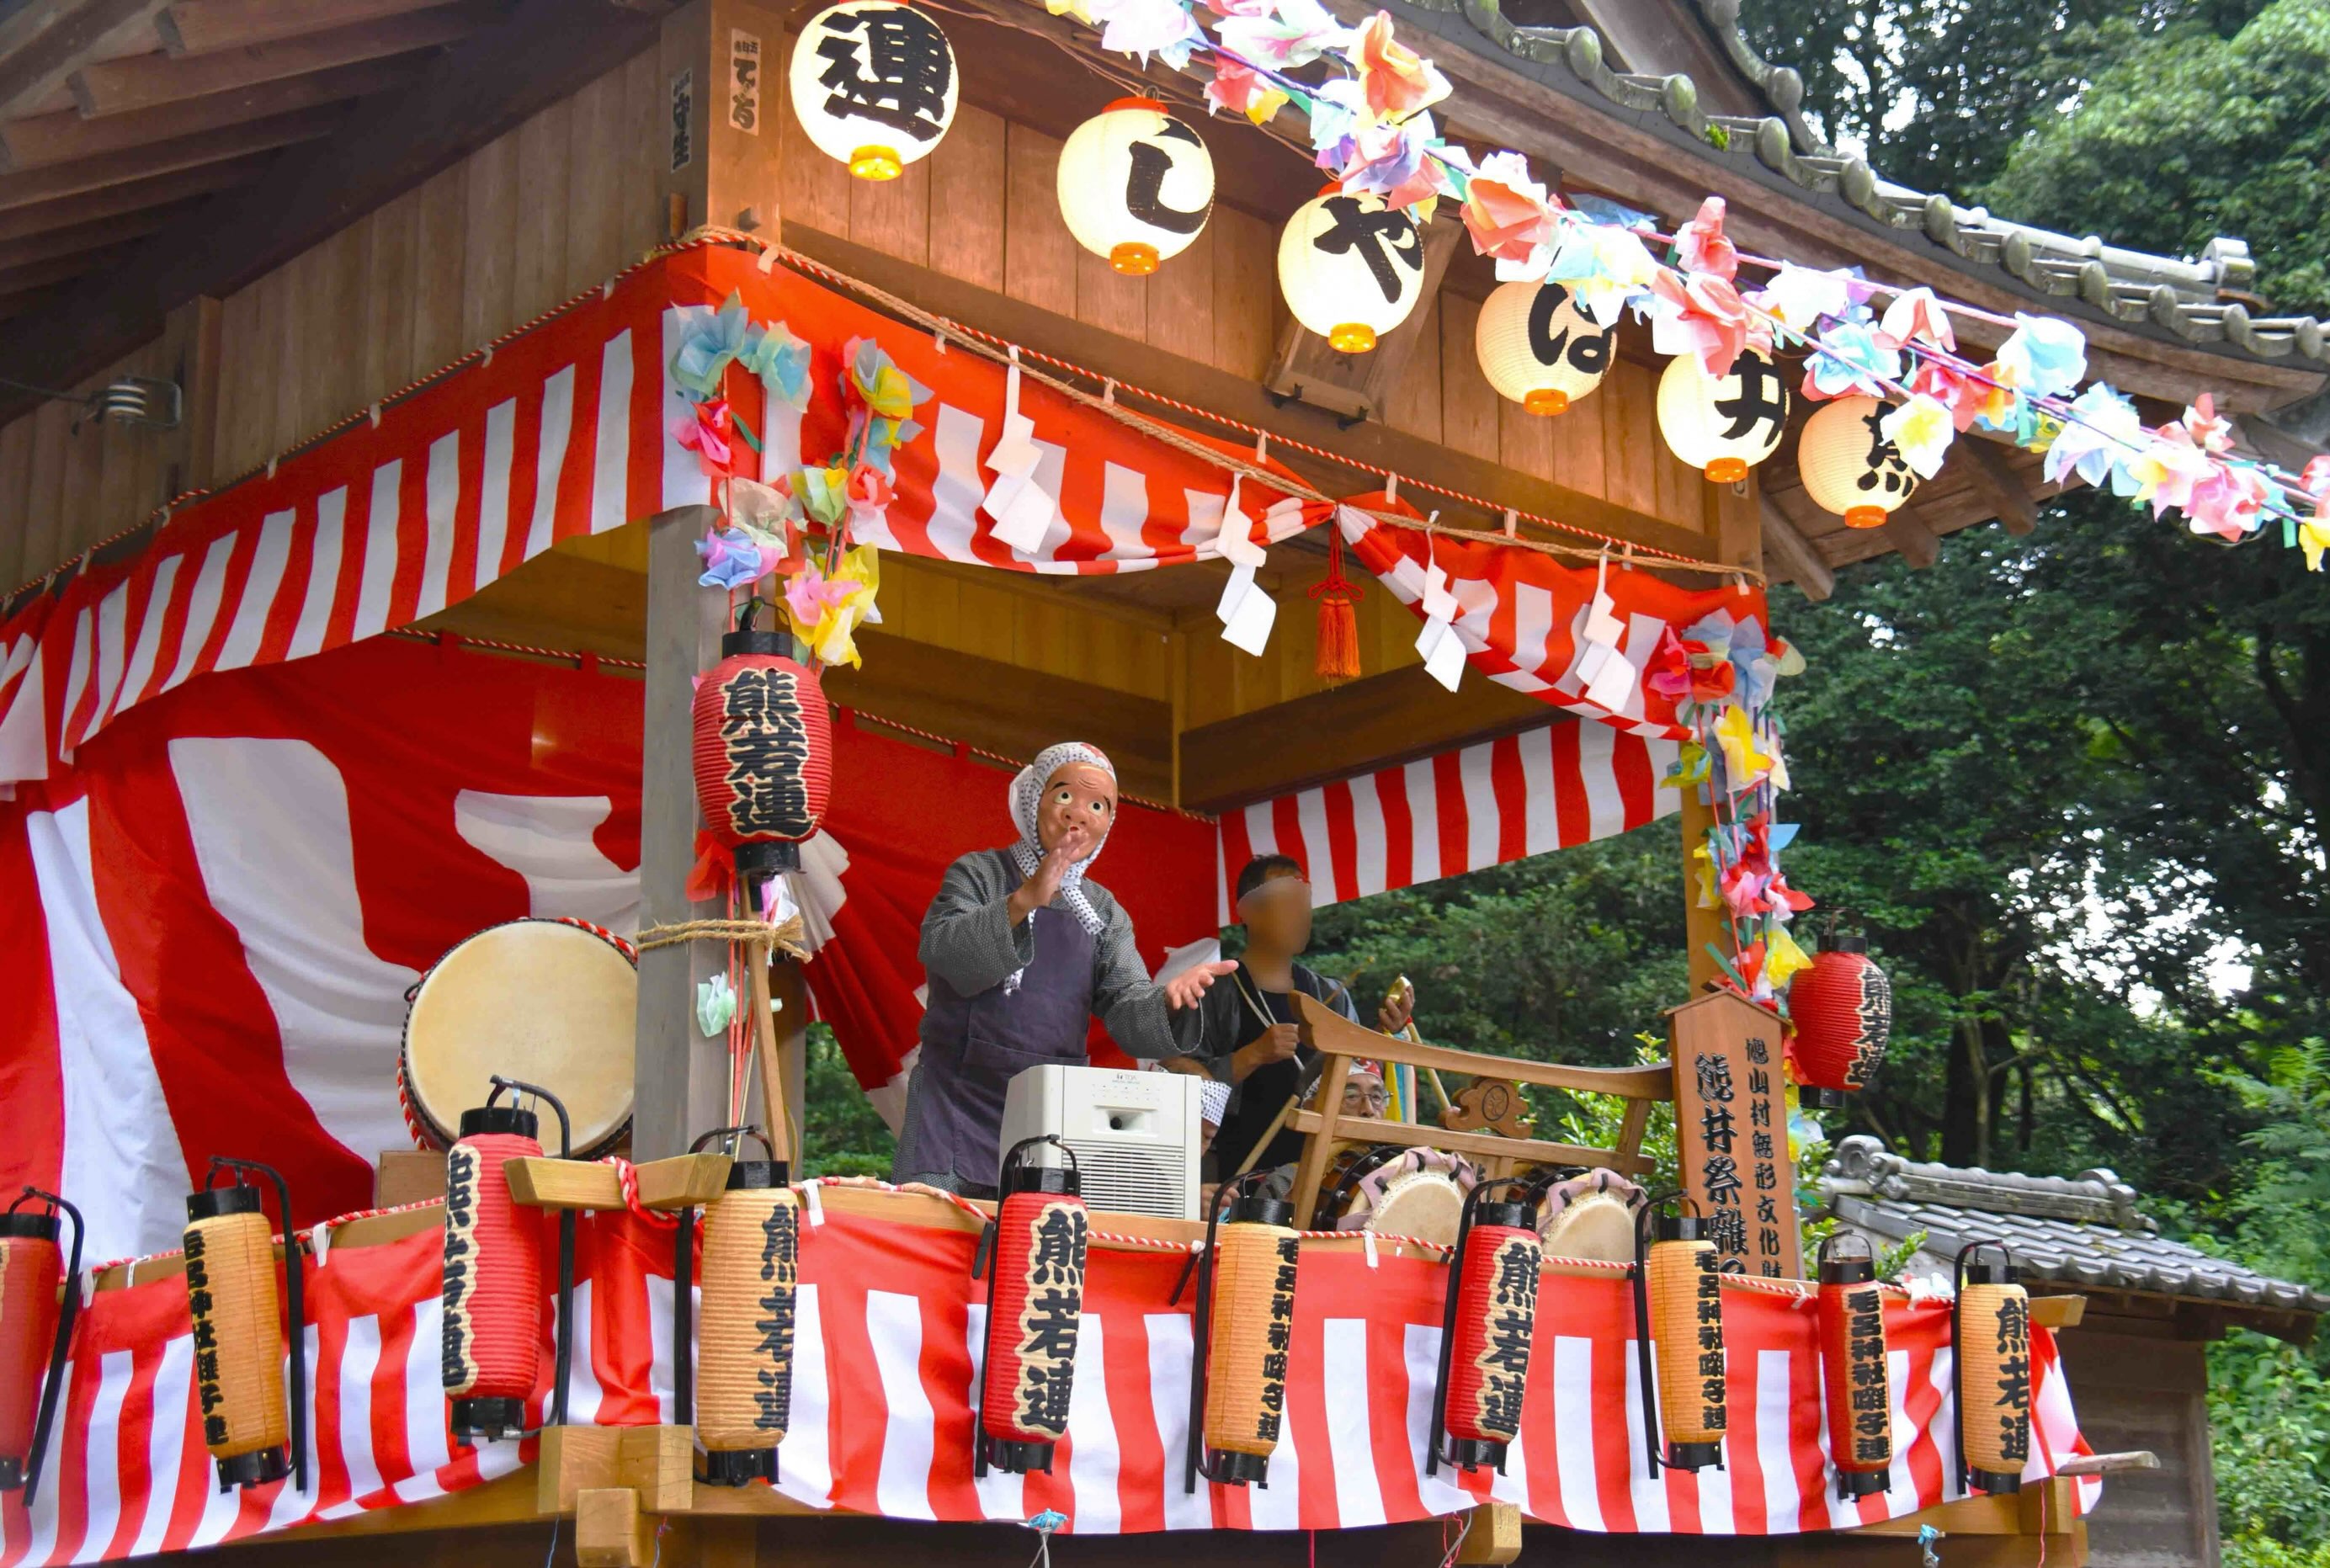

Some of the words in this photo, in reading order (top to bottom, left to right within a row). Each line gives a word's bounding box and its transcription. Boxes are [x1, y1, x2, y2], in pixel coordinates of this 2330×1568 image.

[818, 8, 951, 142] 連
[1313, 196, 1423, 304] や
[721, 670, 816, 837] 熊若連
[1020, 1209, 1088, 1433] 熊若連
[1482, 1242, 1541, 1432] 熊若連
[1994, 1297, 2029, 1462] 熊若連
